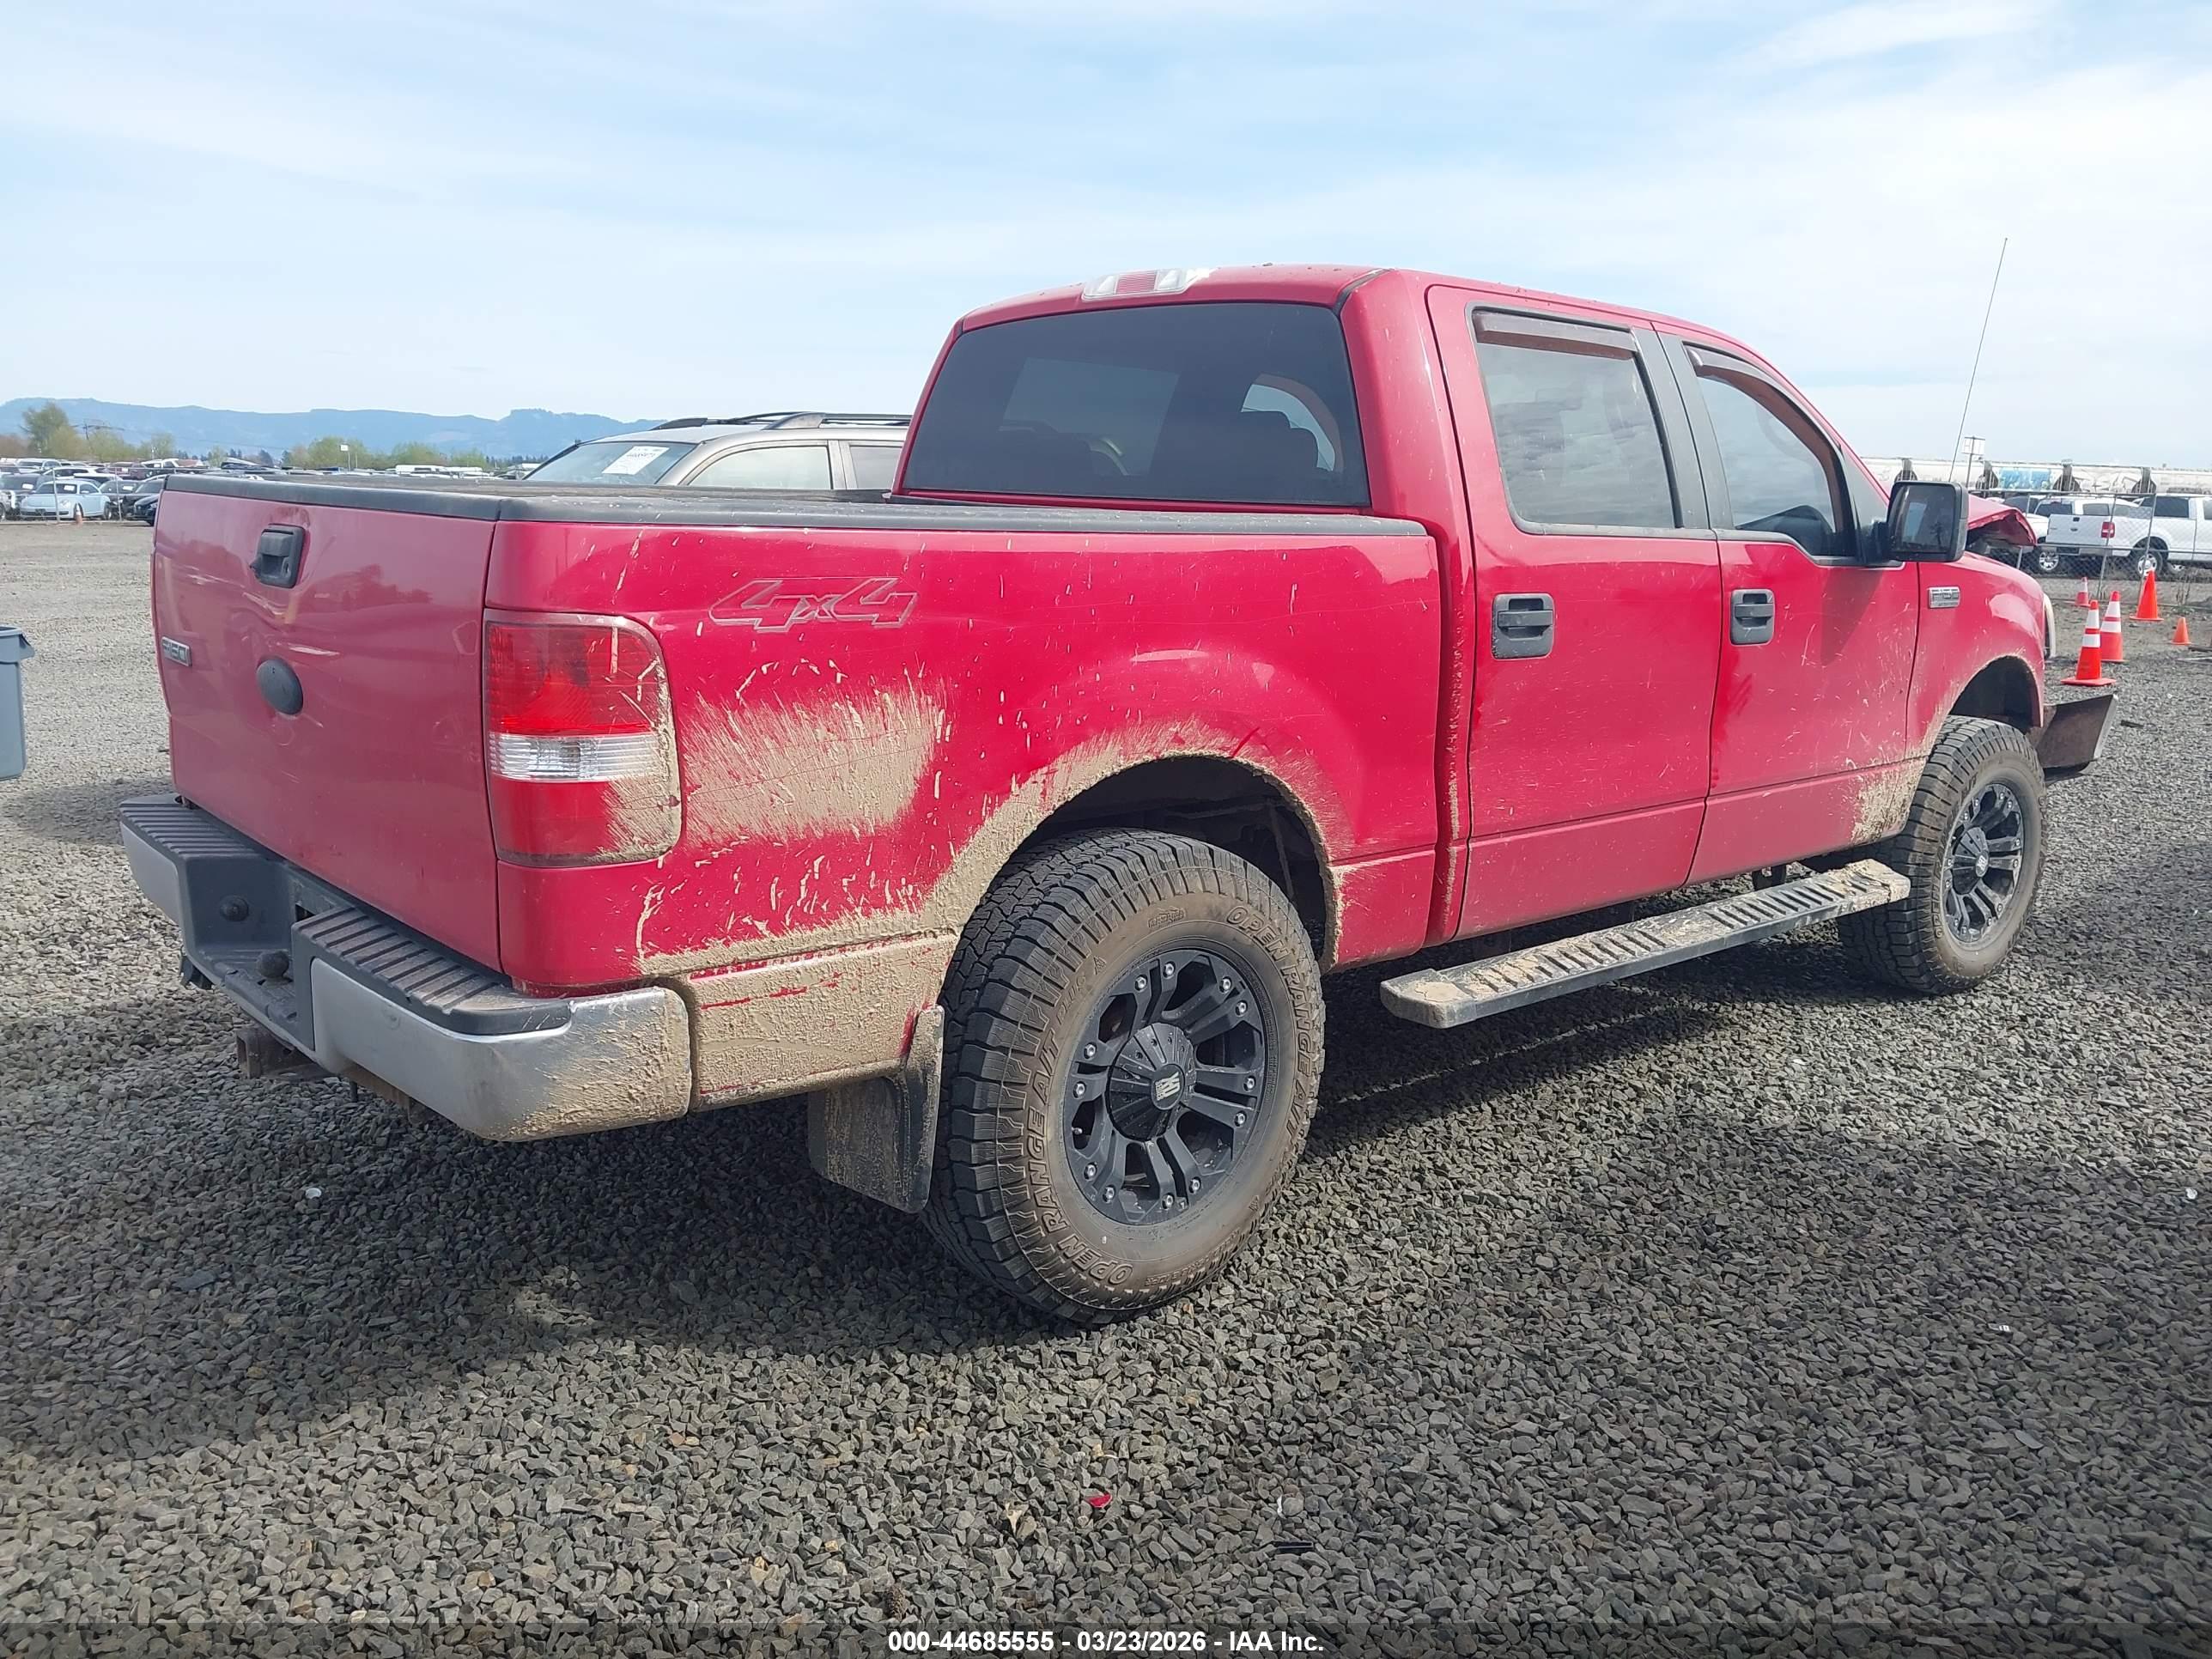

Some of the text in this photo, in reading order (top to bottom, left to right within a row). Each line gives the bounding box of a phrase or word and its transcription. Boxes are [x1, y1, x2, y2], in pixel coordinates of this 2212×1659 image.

[1225, 905, 1290, 963] OPEN
[1280, 964, 1313, 1078] RANGE
[1031, 1029, 1061, 1107] A/T
[1026, 1105, 1070, 1234] RANGE
[1057, 1232, 1135, 1286] OPEN
